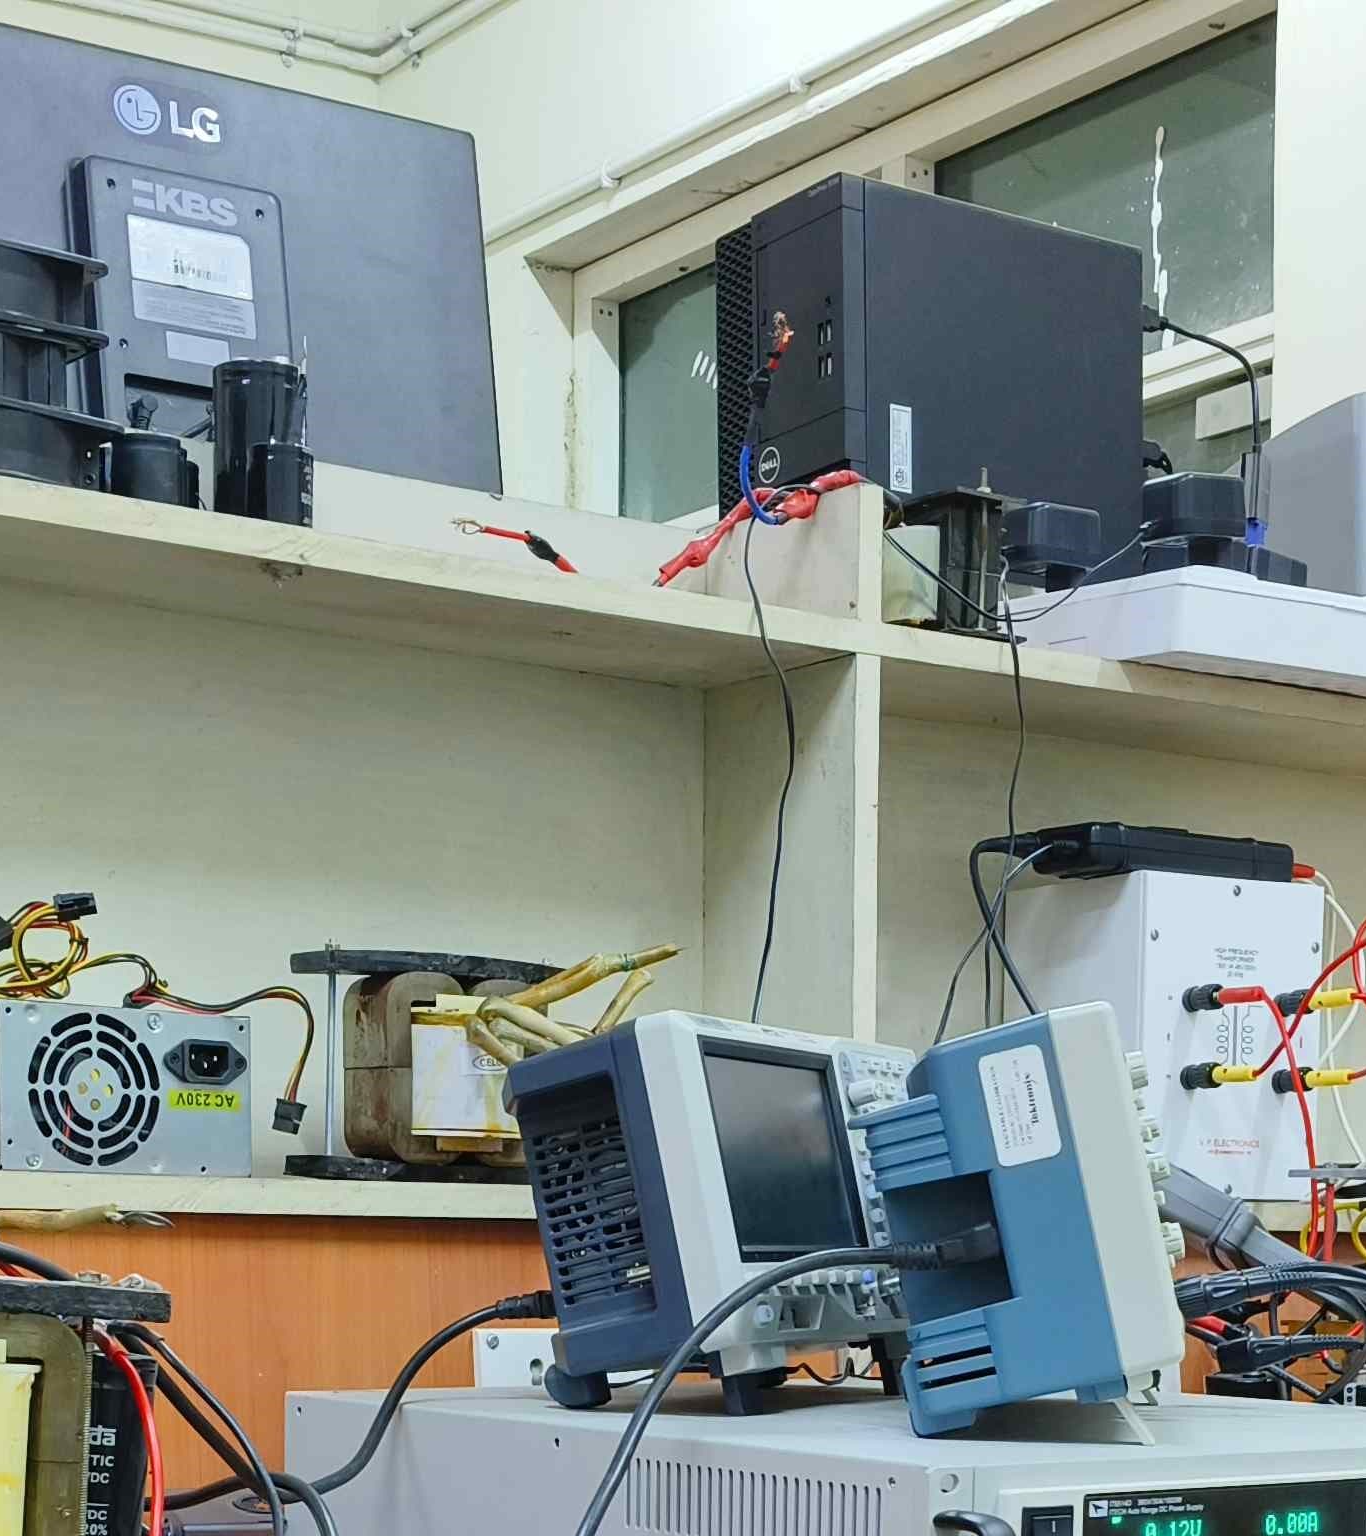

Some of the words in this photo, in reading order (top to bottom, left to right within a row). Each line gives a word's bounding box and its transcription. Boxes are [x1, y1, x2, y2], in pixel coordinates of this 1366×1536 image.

[169, 100, 221, 143] LG
[176, 1092, 211, 1106] 230V
[215, 1094, 235, 1107] AC
[89, 1455, 115, 1467] TIC
[89, 1472, 110, 1483] DC
[87, 1510, 107, 1520] DC
[1265, 1512, 1319, 1536] 0.00A
